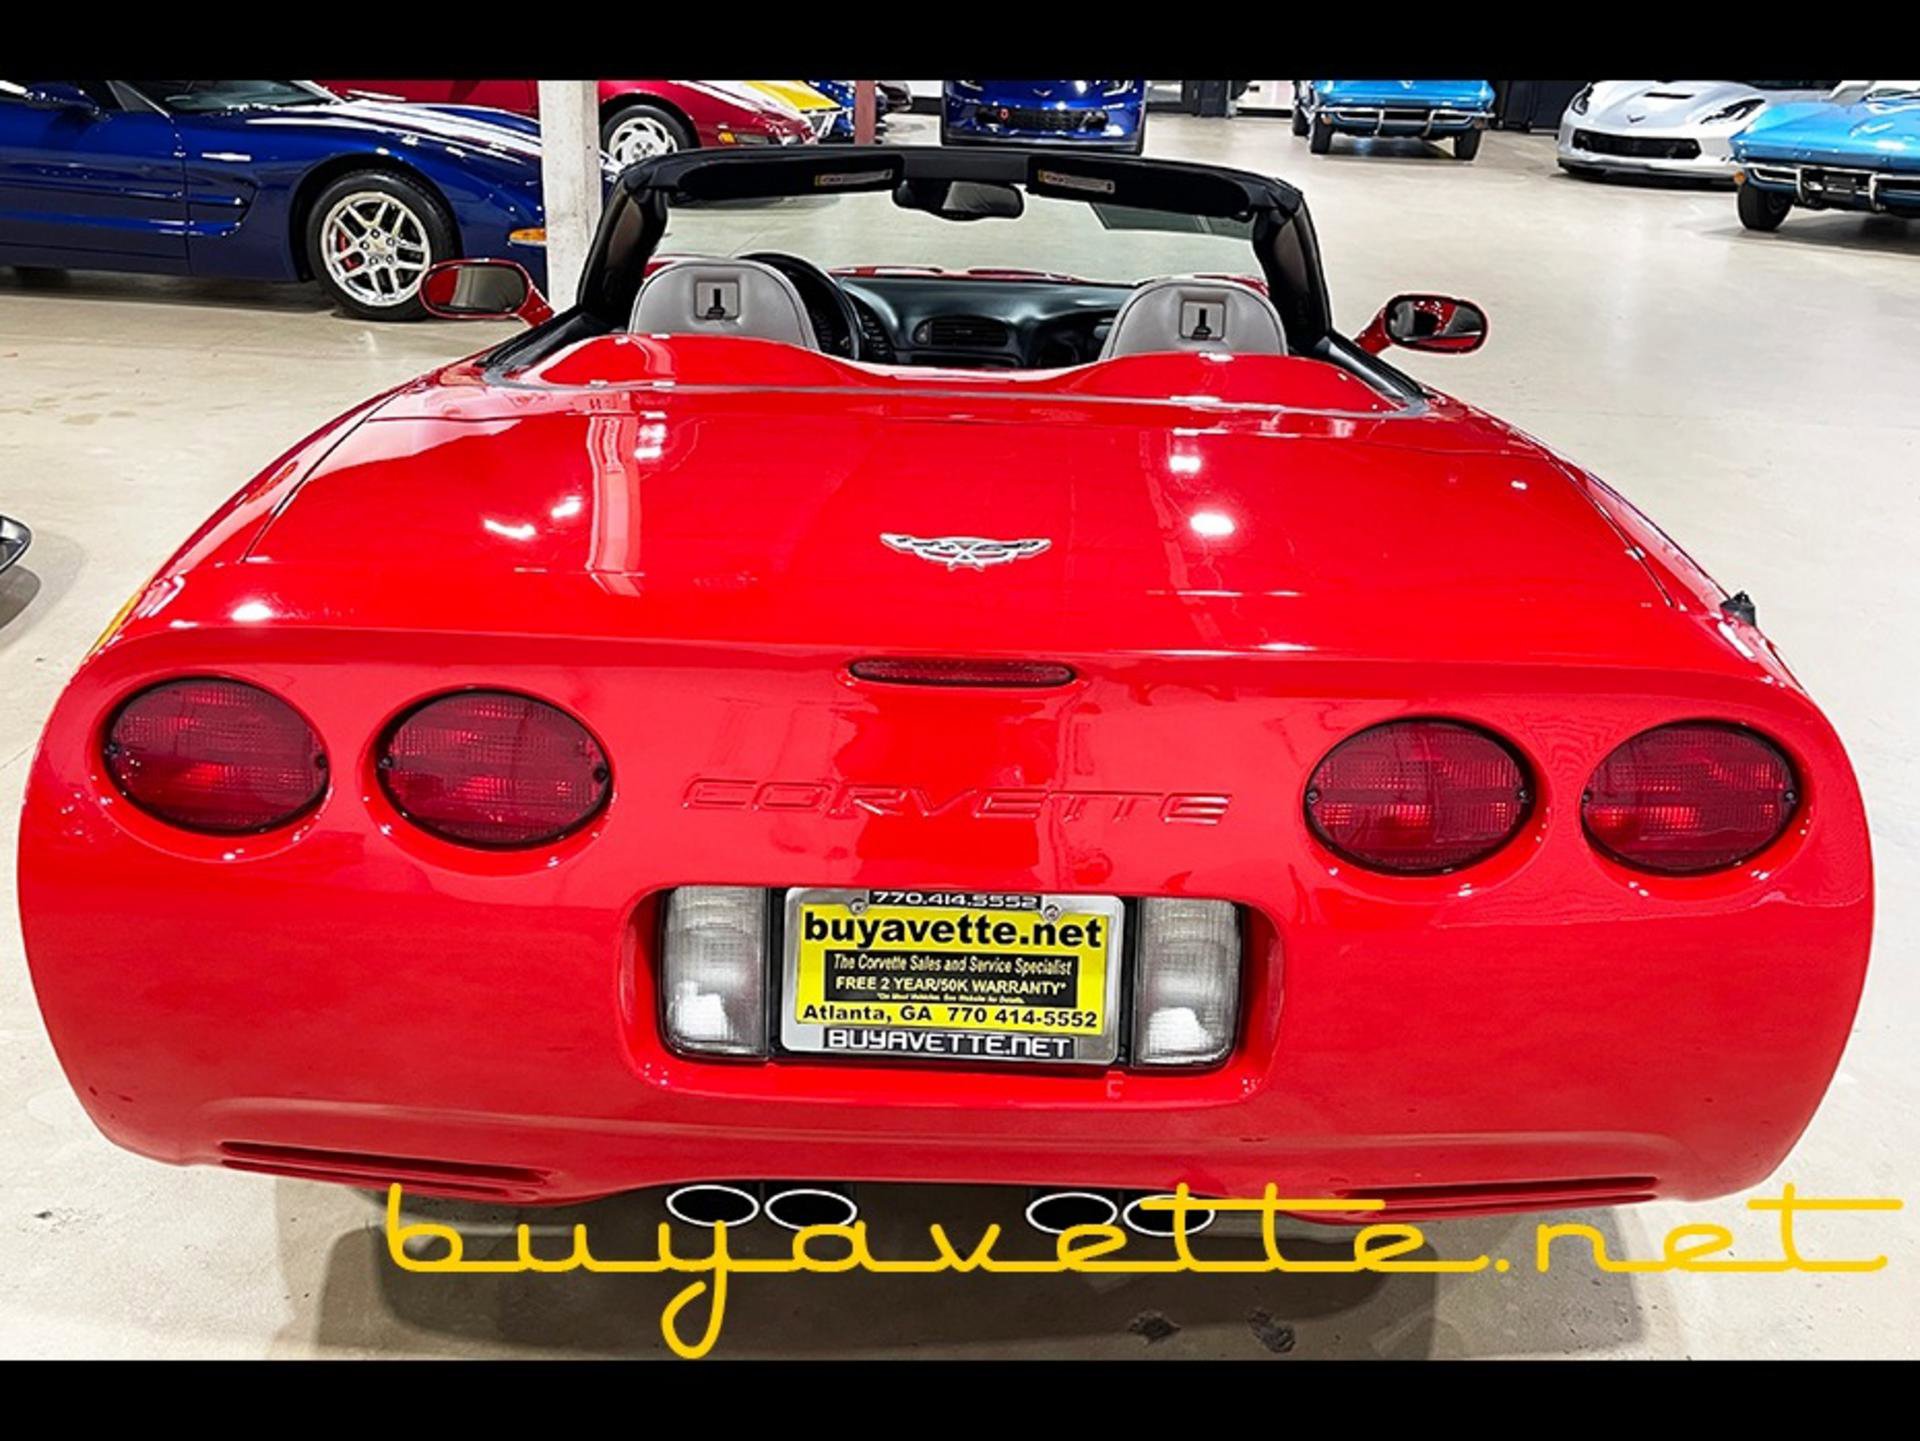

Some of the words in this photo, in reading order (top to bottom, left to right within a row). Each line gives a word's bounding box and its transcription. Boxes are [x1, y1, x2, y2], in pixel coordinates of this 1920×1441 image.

[677, 778, 1232, 826] CORVETTE
[873, 891, 1037, 908] 770.414.5552
[804, 911, 1101, 949] buyavette.net
[834, 953, 854, 970] The
[858, 954, 907, 971] Corvette
[909, 955, 941, 972] Sales
[943, 955, 967, 972] and
[969, 956, 1012, 974] Service
[1014, 957, 1072, 977] Specialist
[835, 975, 877, 990] FREE
[880, 977, 890, 990] 2
[893, 978, 968, 992] YEAR/50K
[803, 1004, 892, 1023] Atlanta,
[900, 1005, 933, 1021] GA
[947, 1006, 987, 1023] 770
[994, 1009, 1097, 1028] 414-5552
